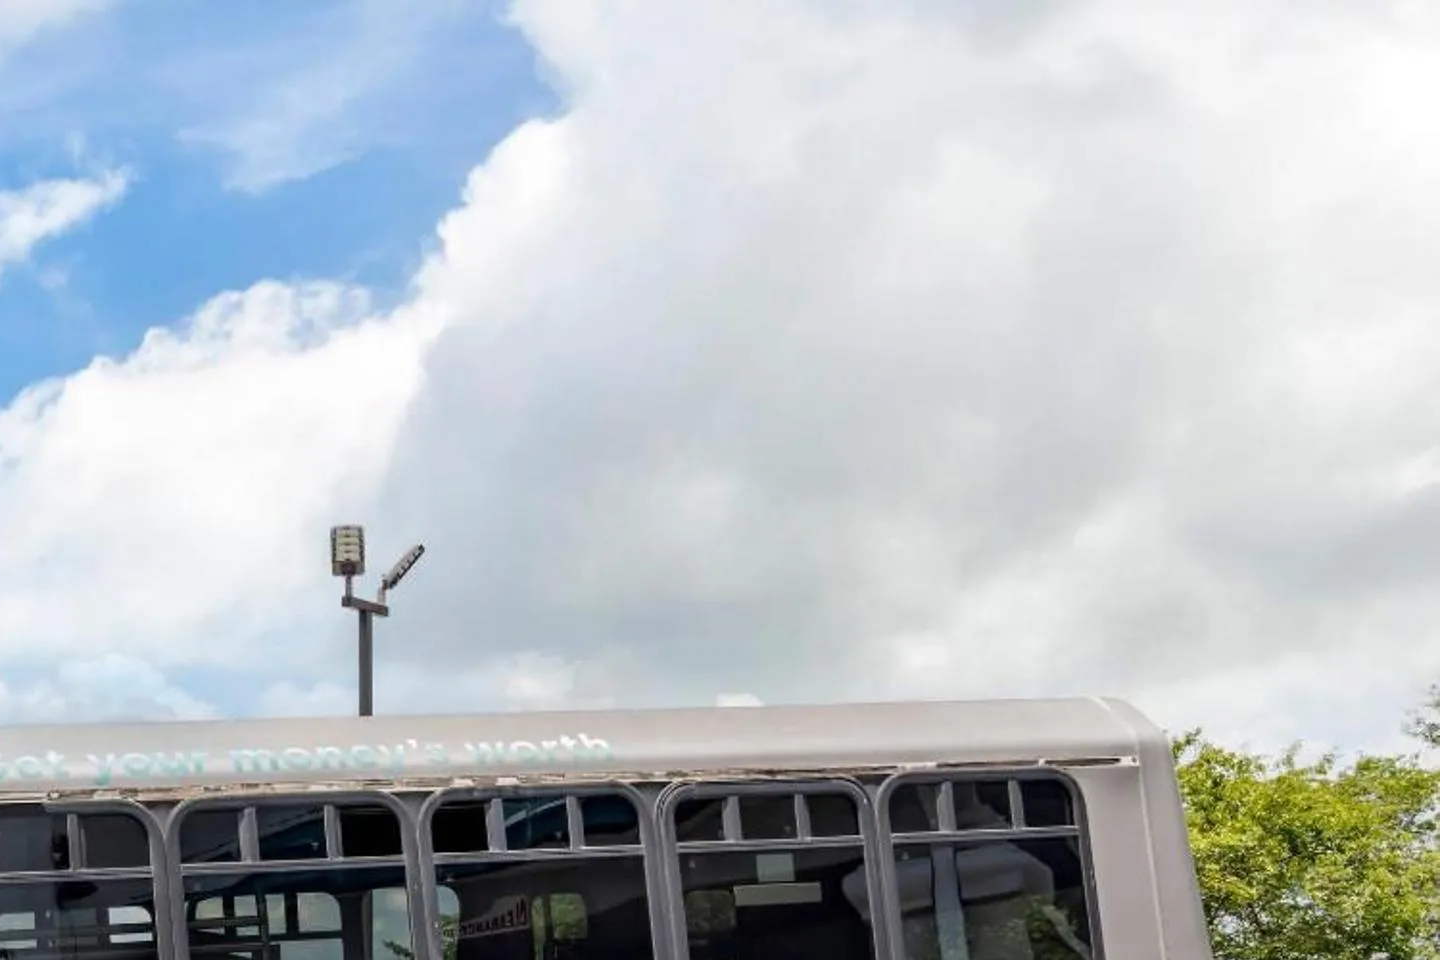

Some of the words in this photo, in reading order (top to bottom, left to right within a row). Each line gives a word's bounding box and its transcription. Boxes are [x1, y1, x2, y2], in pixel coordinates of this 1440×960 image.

[86, 751, 208, 786] your
[232, 738, 452, 775] money's
[463, 732, 615, 766] worth
